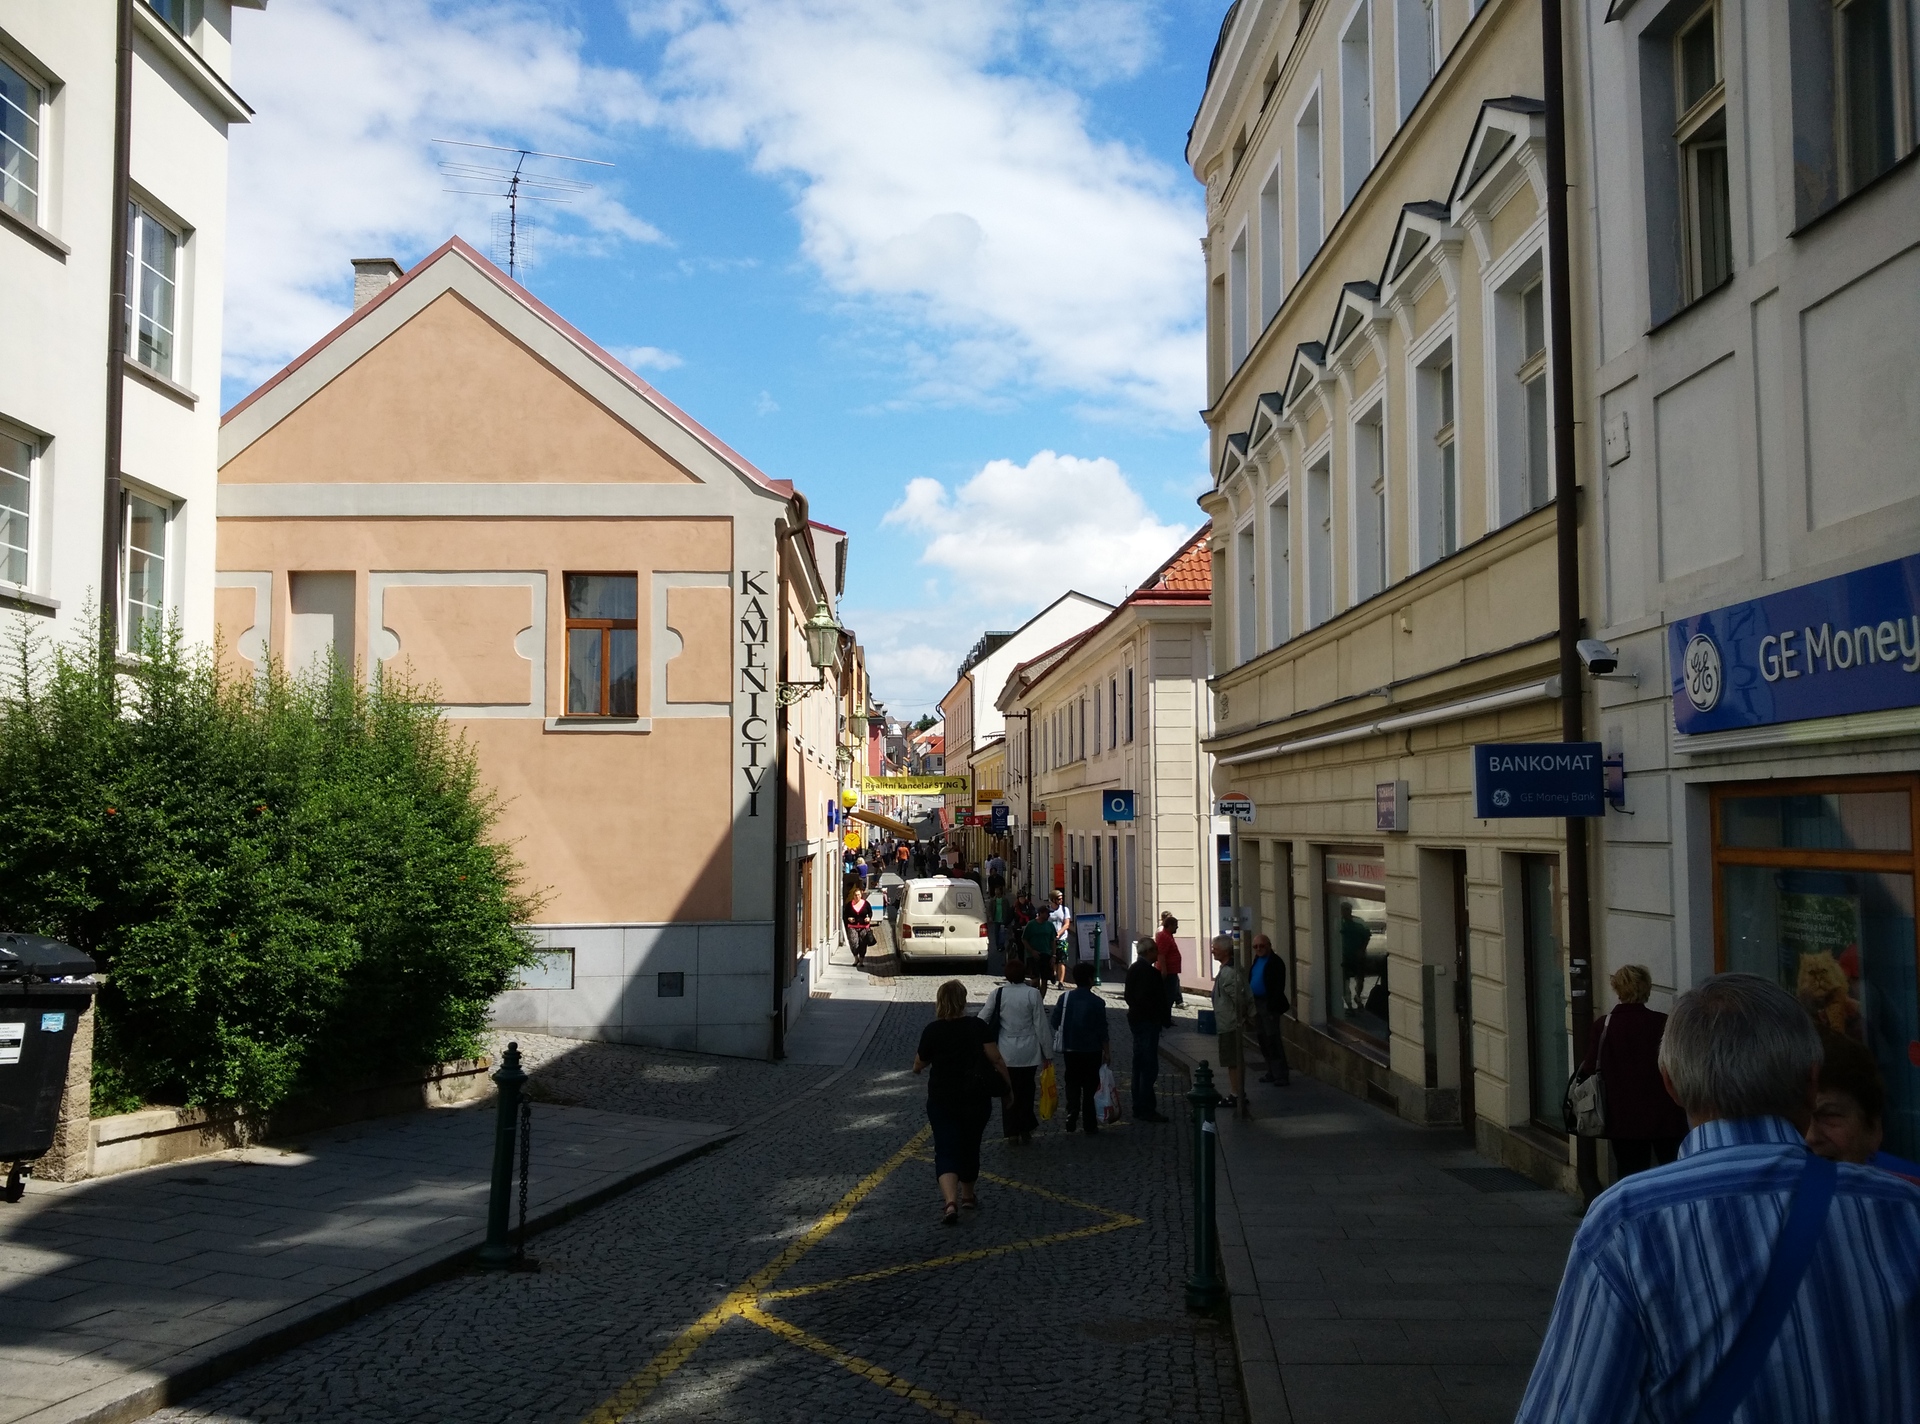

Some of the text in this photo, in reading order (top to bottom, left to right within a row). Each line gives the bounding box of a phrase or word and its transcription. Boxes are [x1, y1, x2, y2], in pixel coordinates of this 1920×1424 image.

[1758, 629, 1801, 683] GE
[1804, 614, 1920, 675] Money
[740, 570, 769, 817] KAMENICTVÍ
[1489, 754, 1594, 772] BANKOMAT
[934, 781, 959, 789] STING
[1520, 791, 1596, 804] GE Money Bank
